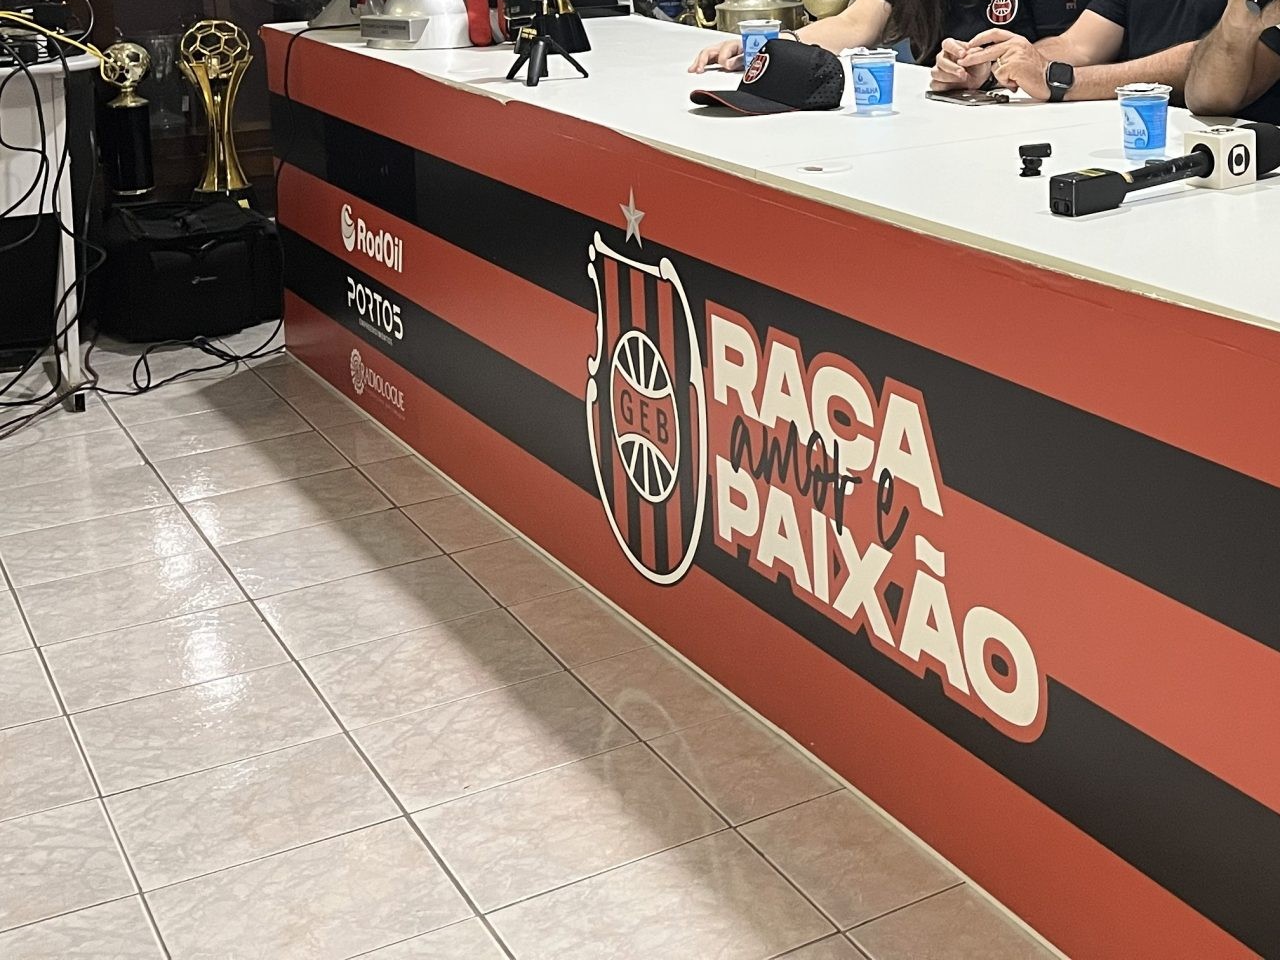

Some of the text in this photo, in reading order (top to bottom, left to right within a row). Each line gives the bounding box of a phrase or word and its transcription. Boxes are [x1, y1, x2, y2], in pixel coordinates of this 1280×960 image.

[358, 218, 403, 273] RodOil
[711, 313, 944, 517] RAÇA
[730, 415, 909, 550] amor e
[717, 454, 1040, 727] PAIXÃO
